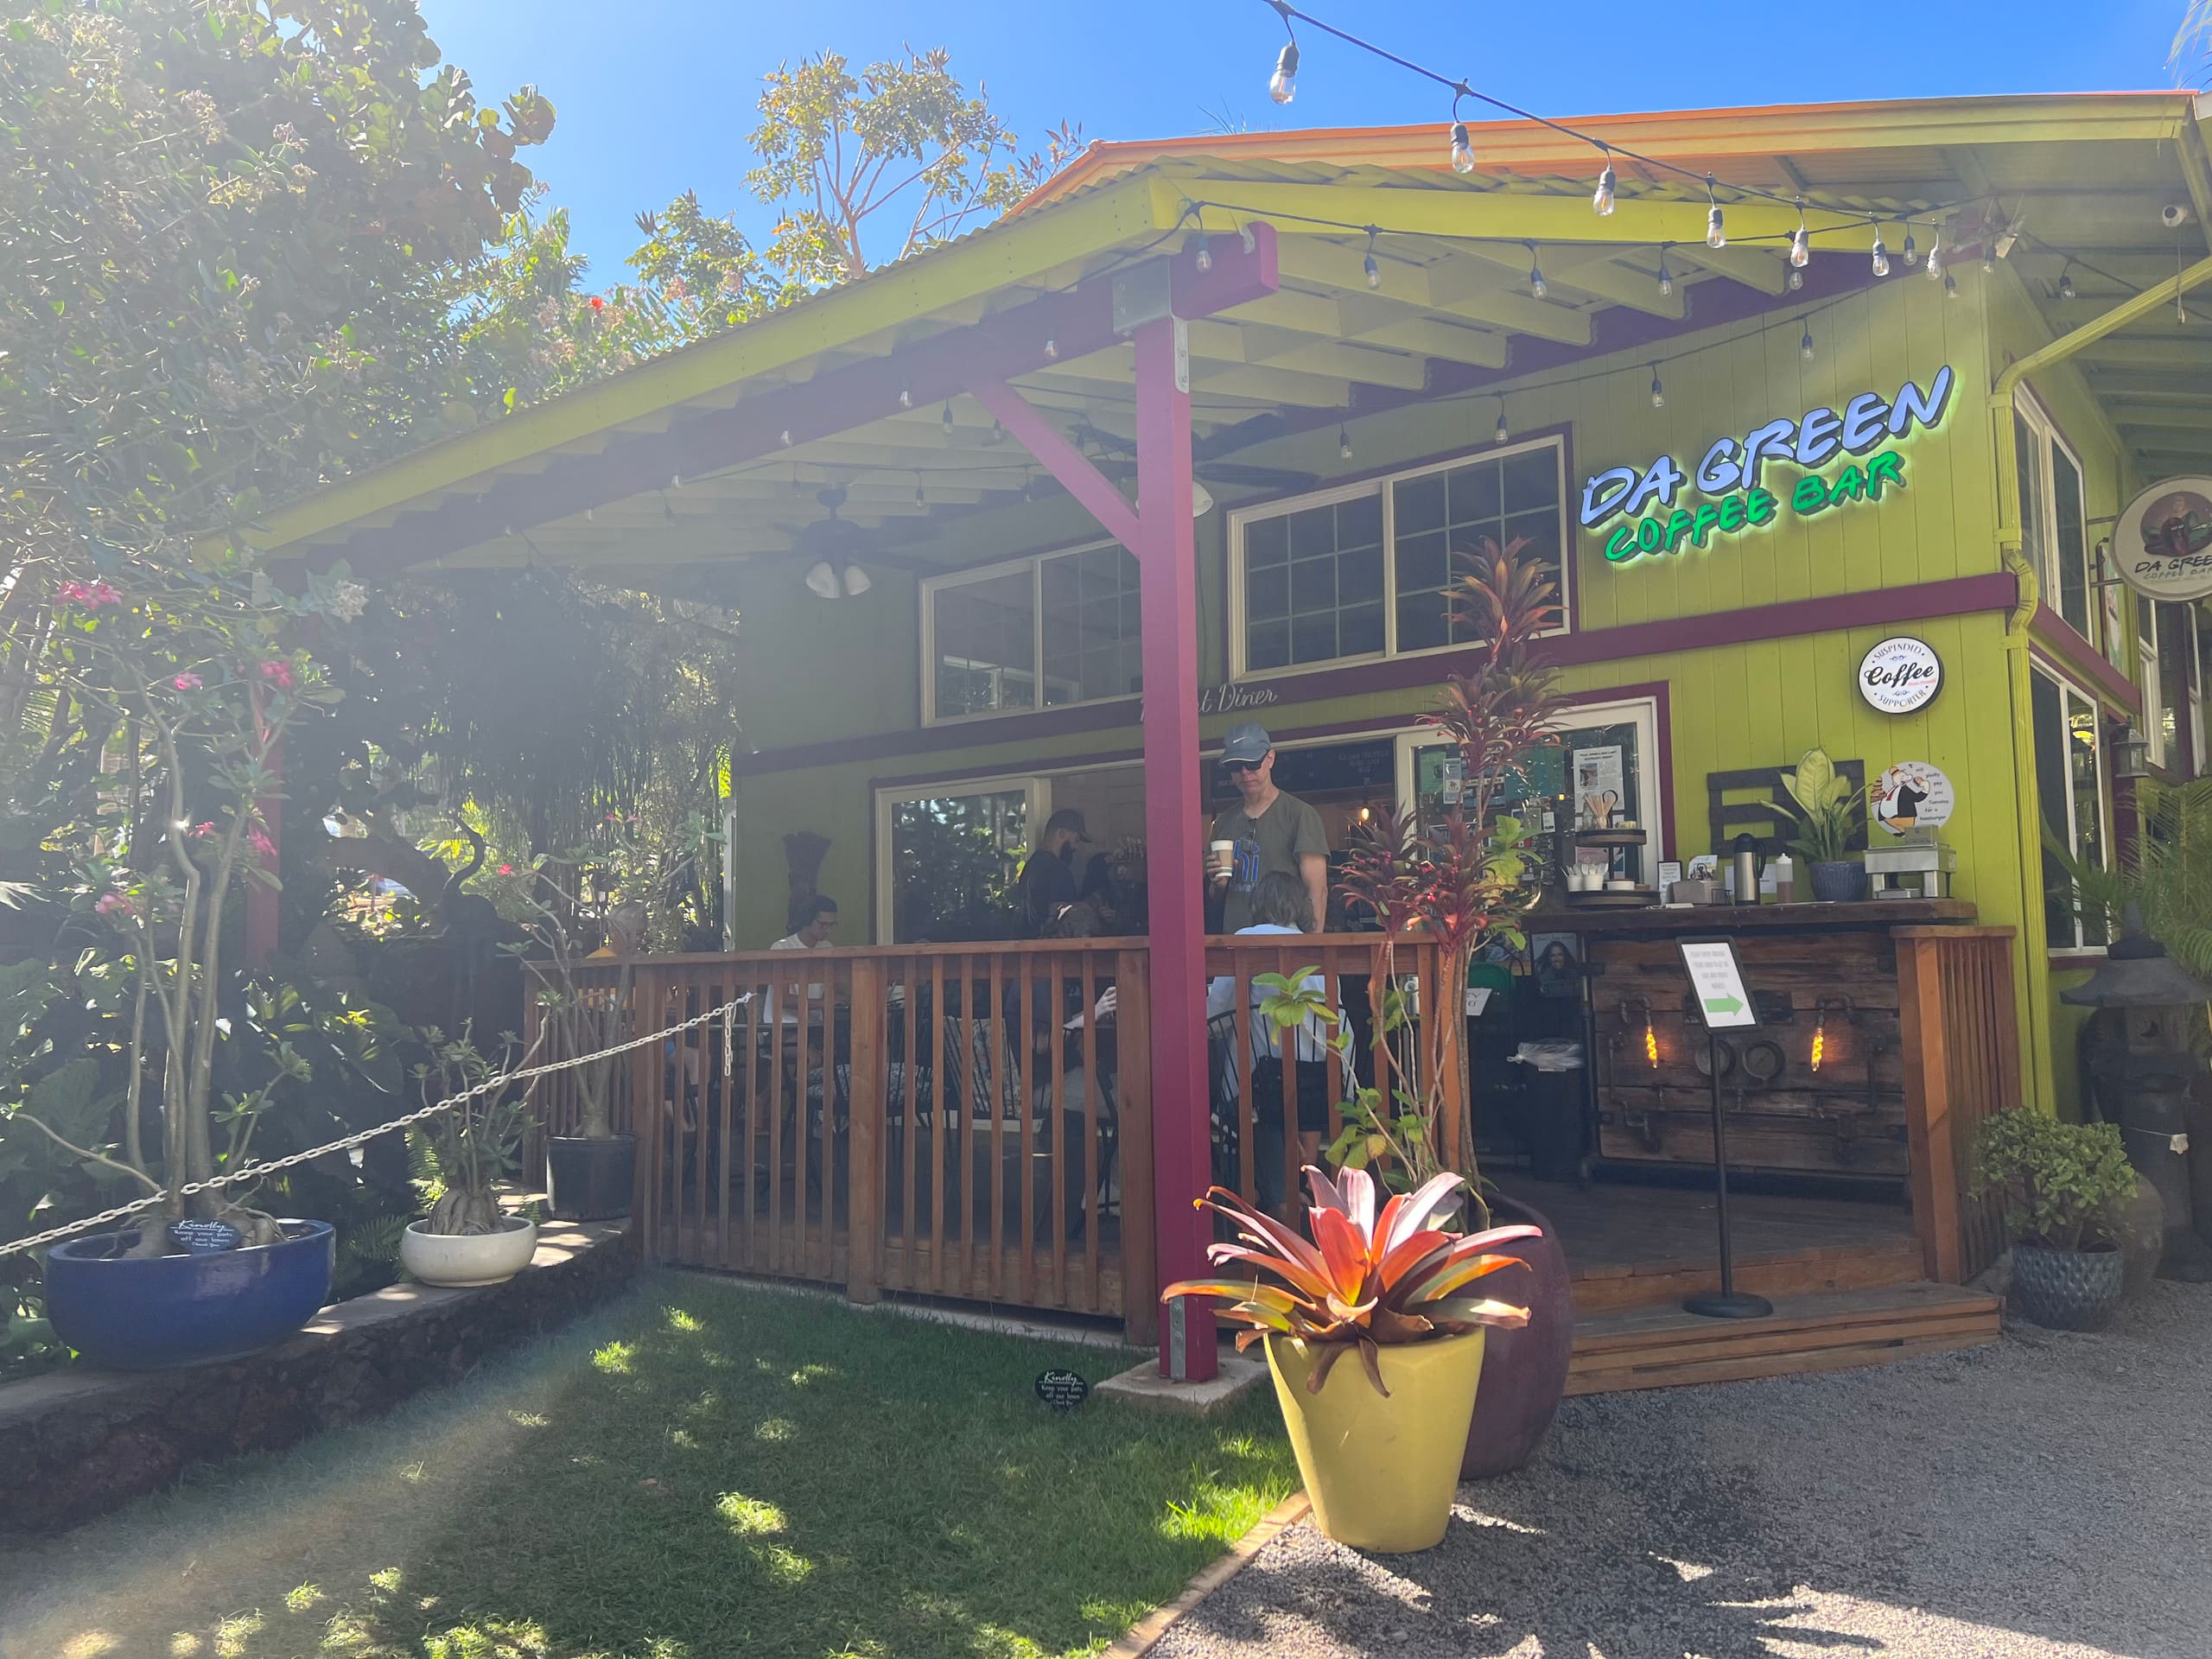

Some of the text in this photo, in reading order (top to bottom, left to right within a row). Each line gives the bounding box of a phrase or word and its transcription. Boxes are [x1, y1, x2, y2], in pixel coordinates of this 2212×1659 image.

[1580, 365, 1954, 527] DA GREEN
[1605, 451, 1905, 563] COFFEE BAR
[2135, 555, 2212, 574] DA GREE
[2144, 569, 2184, 581] COFFEE
[1873, 643, 1923, 659] SUSPENDED
[1864, 662, 1935, 689] Coffee
[1218, 683, 1279, 713] Diner
[1878, 690, 1927, 707] SUPPORTER
[178, 1219, 225, 1233] Kindly
[1044, 1371, 1077, 1387] Kindly
